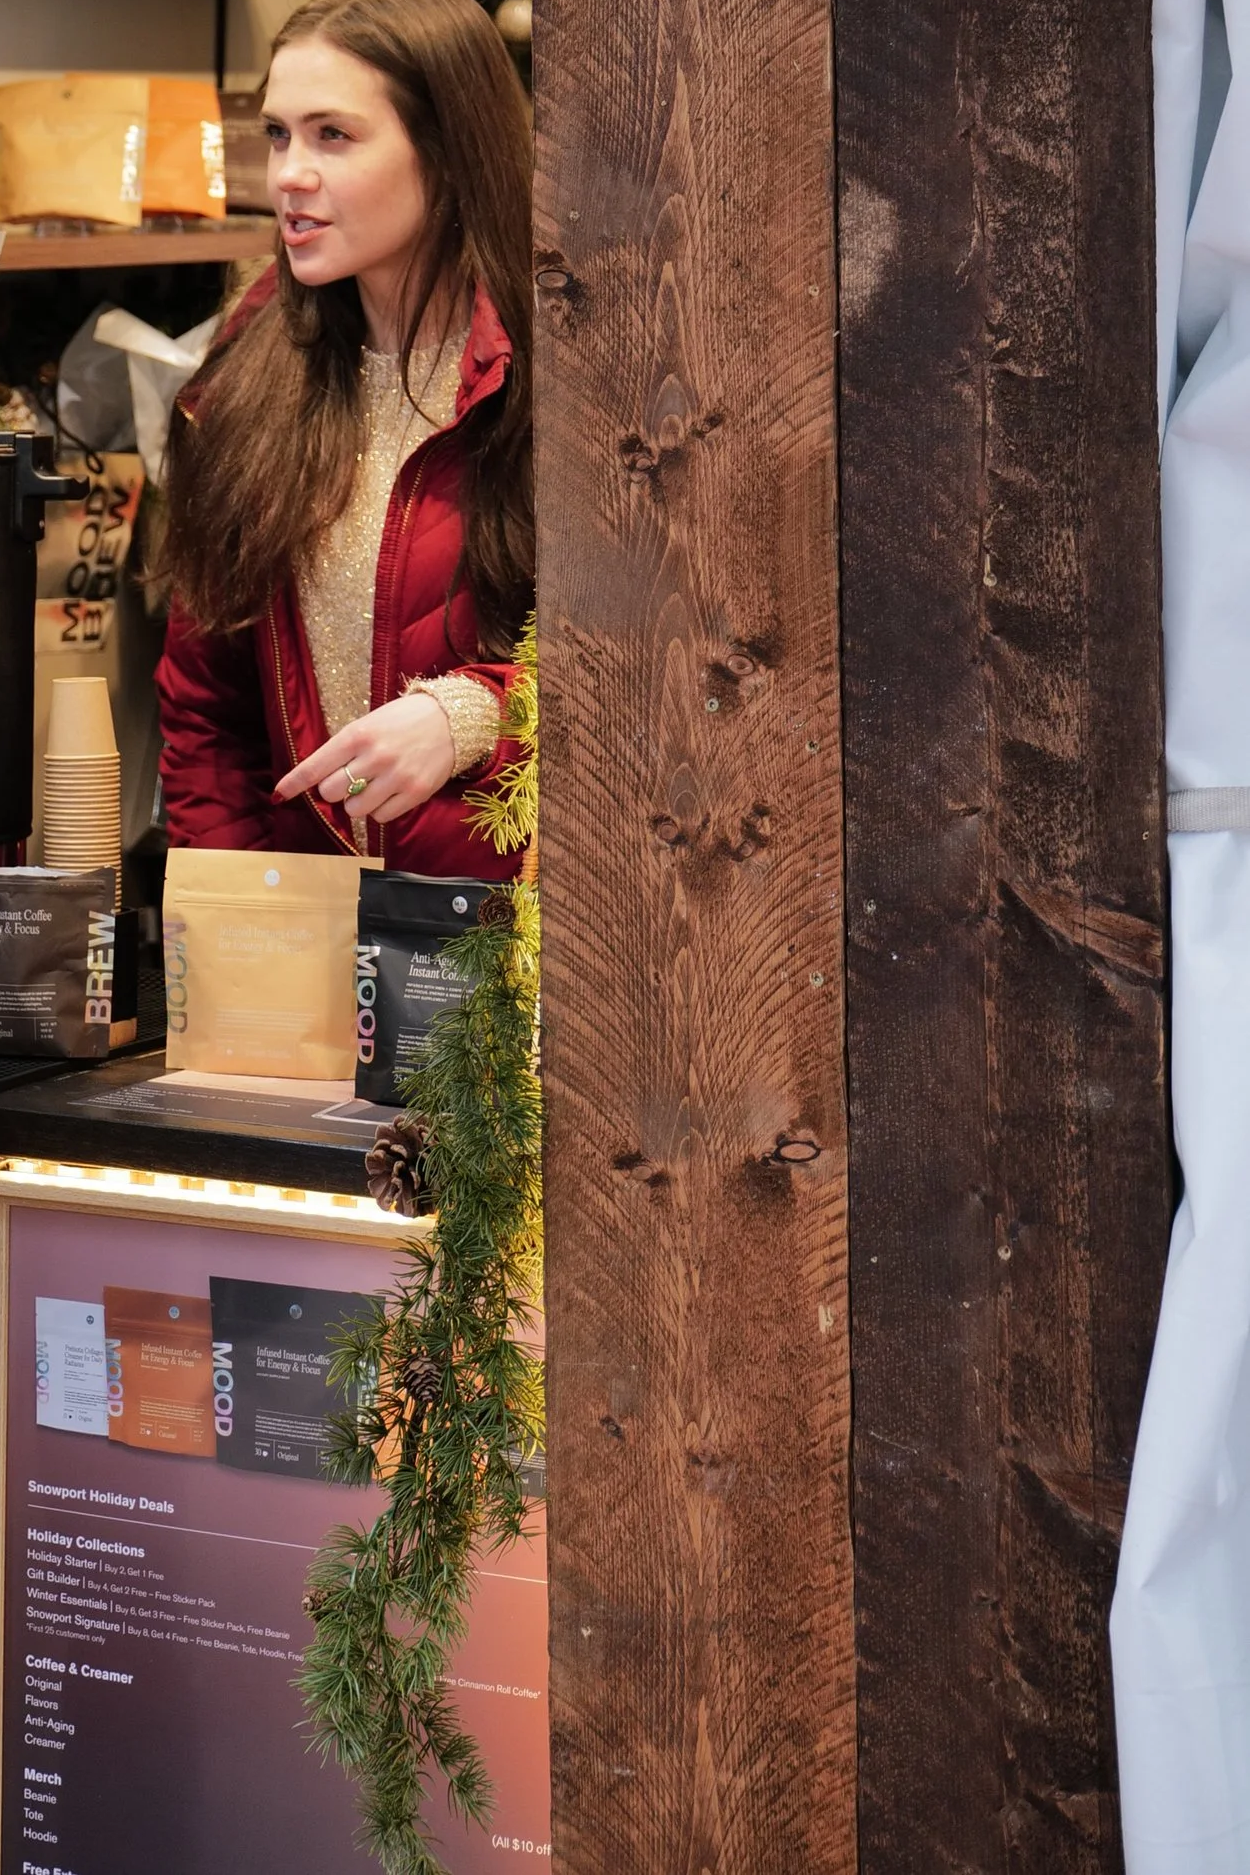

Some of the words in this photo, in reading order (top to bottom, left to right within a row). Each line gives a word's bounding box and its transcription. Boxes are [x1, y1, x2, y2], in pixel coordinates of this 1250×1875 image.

[23, 909, 52, 922] Coffee
[4, 922, 13, 934] &
[14, 922, 40, 935] Focus
[163, 916, 188, 1034] MOOD
[409, 964, 439, 979] Instant
[356, 945, 381, 1064] MOOD
[256, 1346, 281, 1359] Infused
[282, 1349, 307, 1363] Instant
[308, 1353, 330, 1365] Coffee
[256, 1357, 267, 1368] for
[267, 1359, 291, 1373] Energy
[301, 1363, 321, 1375] Focus
[106, 1338, 124, 1417] MOOD
[212, 1342, 234, 1437] MOOD
[277, 1451, 299, 1462] Original
[28, 1480, 87, 1501] Snowport
[89, 1489, 136, 1510] Holiday
[139, 1497, 174, 1513] Deals
[27, 1528, 73, 1548] Holiday
[76, 1536, 145, 1558] Collections
[27, 1549, 62, 1566] Holiday
[64, 1554, 97, 1570] Starter
[105, 1564, 119, 1575] Buy
[127, 1567, 140, 1577] Get
[148, 1570, 164, 1580] Free
[27, 1567, 44, 1580] Gift
[47, 1571, 80, 1586] Builder
[88, 1580, 101, 1592] Buy
[110, 1584, 123, 1594] Get
[131, 1587, 147, 1597] Free
[155, 1591, 171, 1601] Free
[173, 1593, 196, 1606] Sticker
[198, 1598, 216, 1609] Pack
[26, 1587, 57, 1603] Winter
[60, 1593, 108, 1611] Essentials
[115, 1604, 129, 1615] Buy
[138, 1608, 151, 1618] Get
[159, 1611, 175, 1621] Free
[183, 1615, 199, 1626] Free
[201, 1618, 225, 1630] Sticker
[226, 1622, 246, 1634] Pack,
[247, 1625, 264, 1636] Free
[265, 1628, 290, 1640] Beanie
[26, 1606, 71, 1624] Snowport
[75, 1615, 120, 1632] Signature
[127, 1626, 142, 1637] Buy
[151, 1630, 164, 1640] Get
[172, 1633, 188, 1643] Free
[196, 1637, 212, 1647] Free
[214, 1640, 240, 1653] Beanie,
[241, 1644, 258, 1655] Tote,
[259, 1647, 287, 1660] Hoodie,
[288, 1651, 304, 1662] Free
[55, 1628, 90, 1642] customers
[91, 1634, 105, 1645] only
[25, 1654, 66, 1673] Coffee
[68, 1662, 78, 1675] &
[81, 1664, 134, 1684] Creamer
[25, 1675, 62, 1691] Original
[457, 1678, 495, 1693] Cinnamon
[496, 1685, 511, 1695] Roll
[25, 1694, 59, 1710] Flavors
[24, 1713, 75, 1735] Anti-Aging
[24, 1733, 66, 1750] Creamer
[24, 1767, 62, 1785] Merch
[24, 1788, 57, 1804] Beanie
[23, 1807, 44, 1821] Tote
[23, 1827, 58, 1843] Hoodie
[492, 1834, 510, 1849] (All
[512, 1837, 534, 1854] $10
[536, 1844, 551, 1856] off
[23, 1861, 50, 1875] Free
